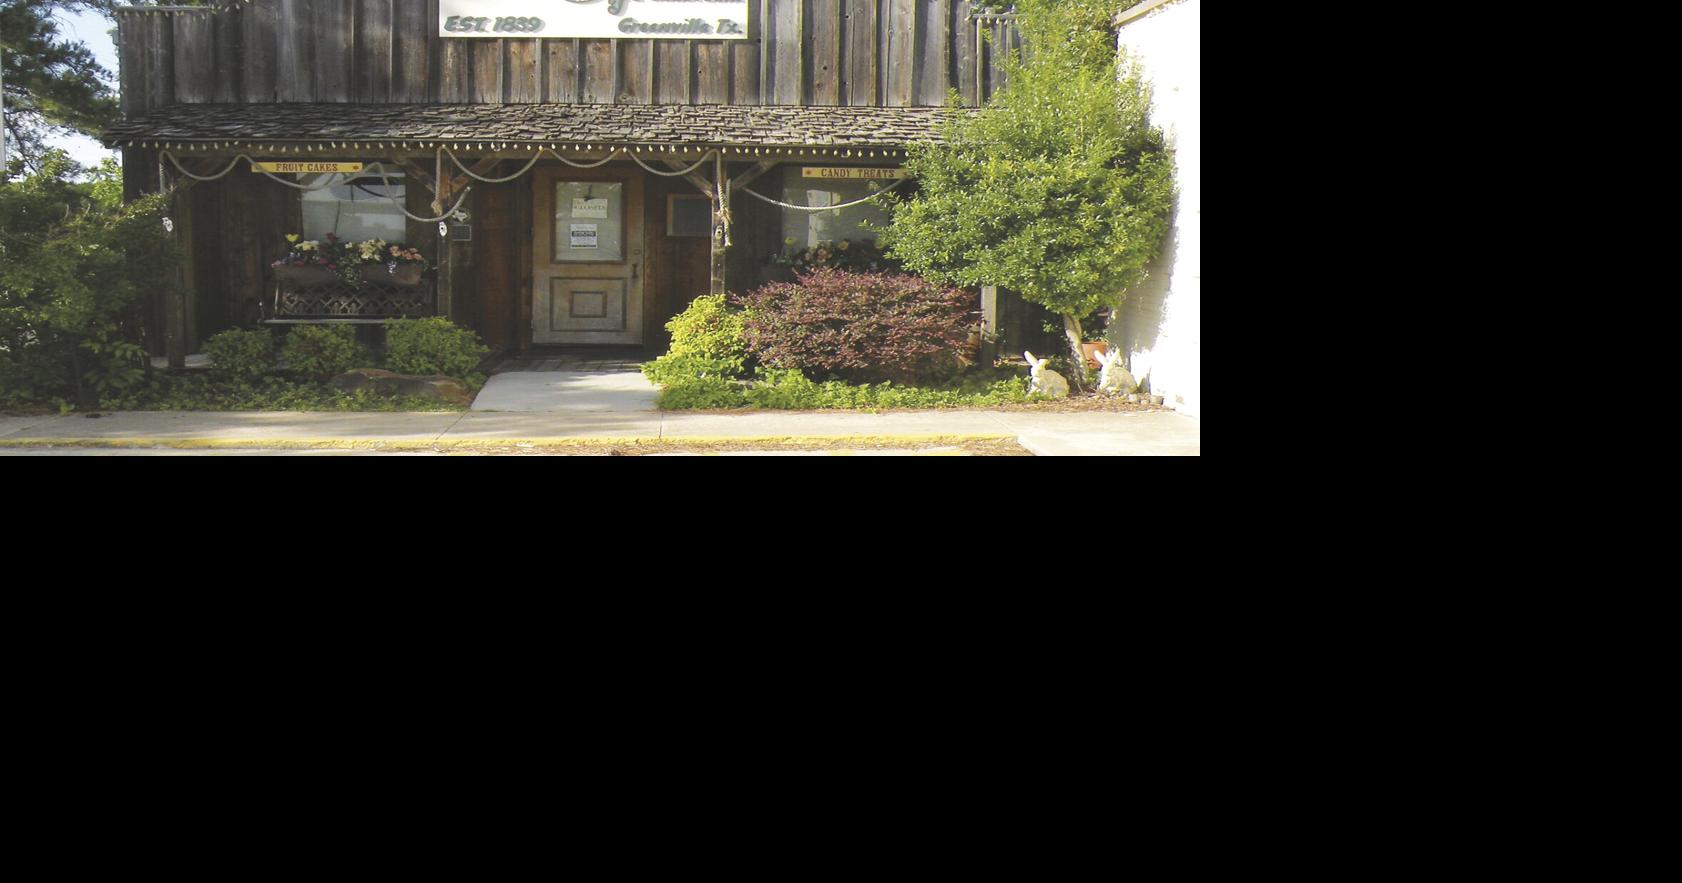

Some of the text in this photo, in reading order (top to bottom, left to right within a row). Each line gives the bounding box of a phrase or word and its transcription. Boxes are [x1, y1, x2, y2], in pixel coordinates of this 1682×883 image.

[493, 16, 546, 33] 1839
[618, 17, 714, 34] Greenville
[276, 163, 338, 172] FRUIT CAKES
[821, 168, 895, 178] CANDY TREATS
